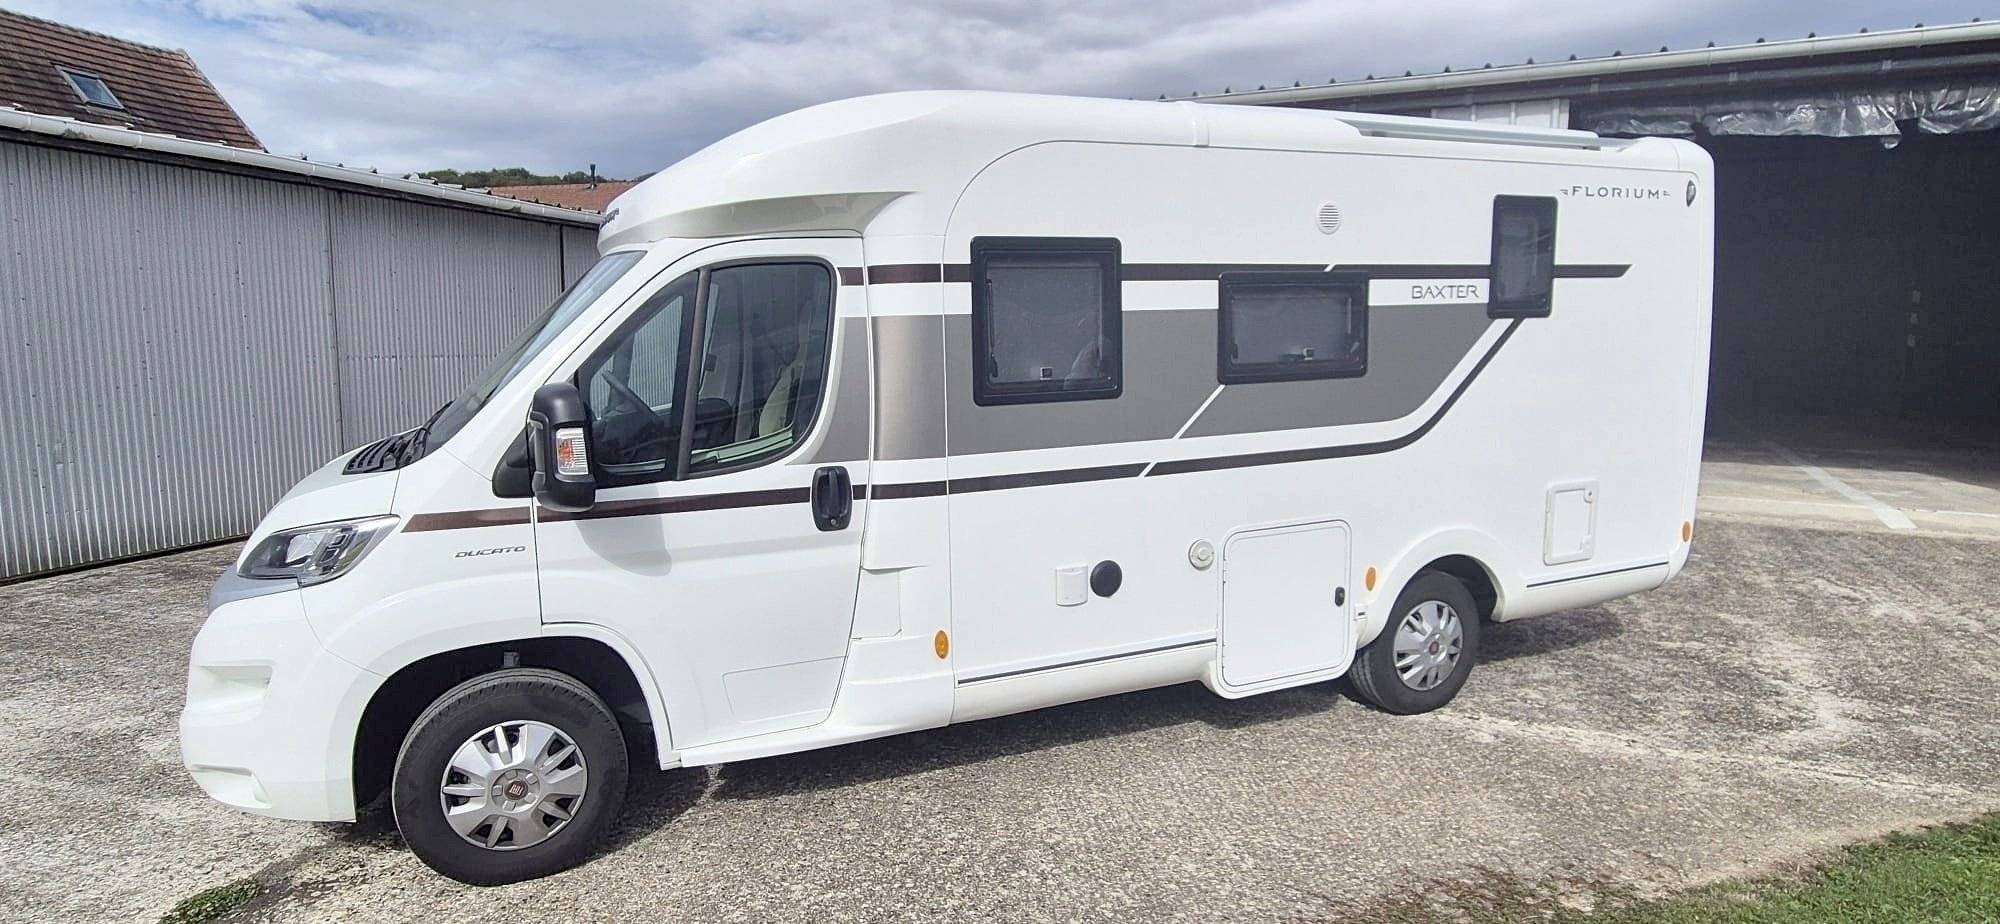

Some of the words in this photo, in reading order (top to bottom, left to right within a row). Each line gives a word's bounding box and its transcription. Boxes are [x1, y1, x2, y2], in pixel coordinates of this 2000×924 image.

[1572, 186, 1660, 199] FLORIUM
[1411, 285, 1479, 299] BAXTER
[455, 545, 527, 558] DUCATO
